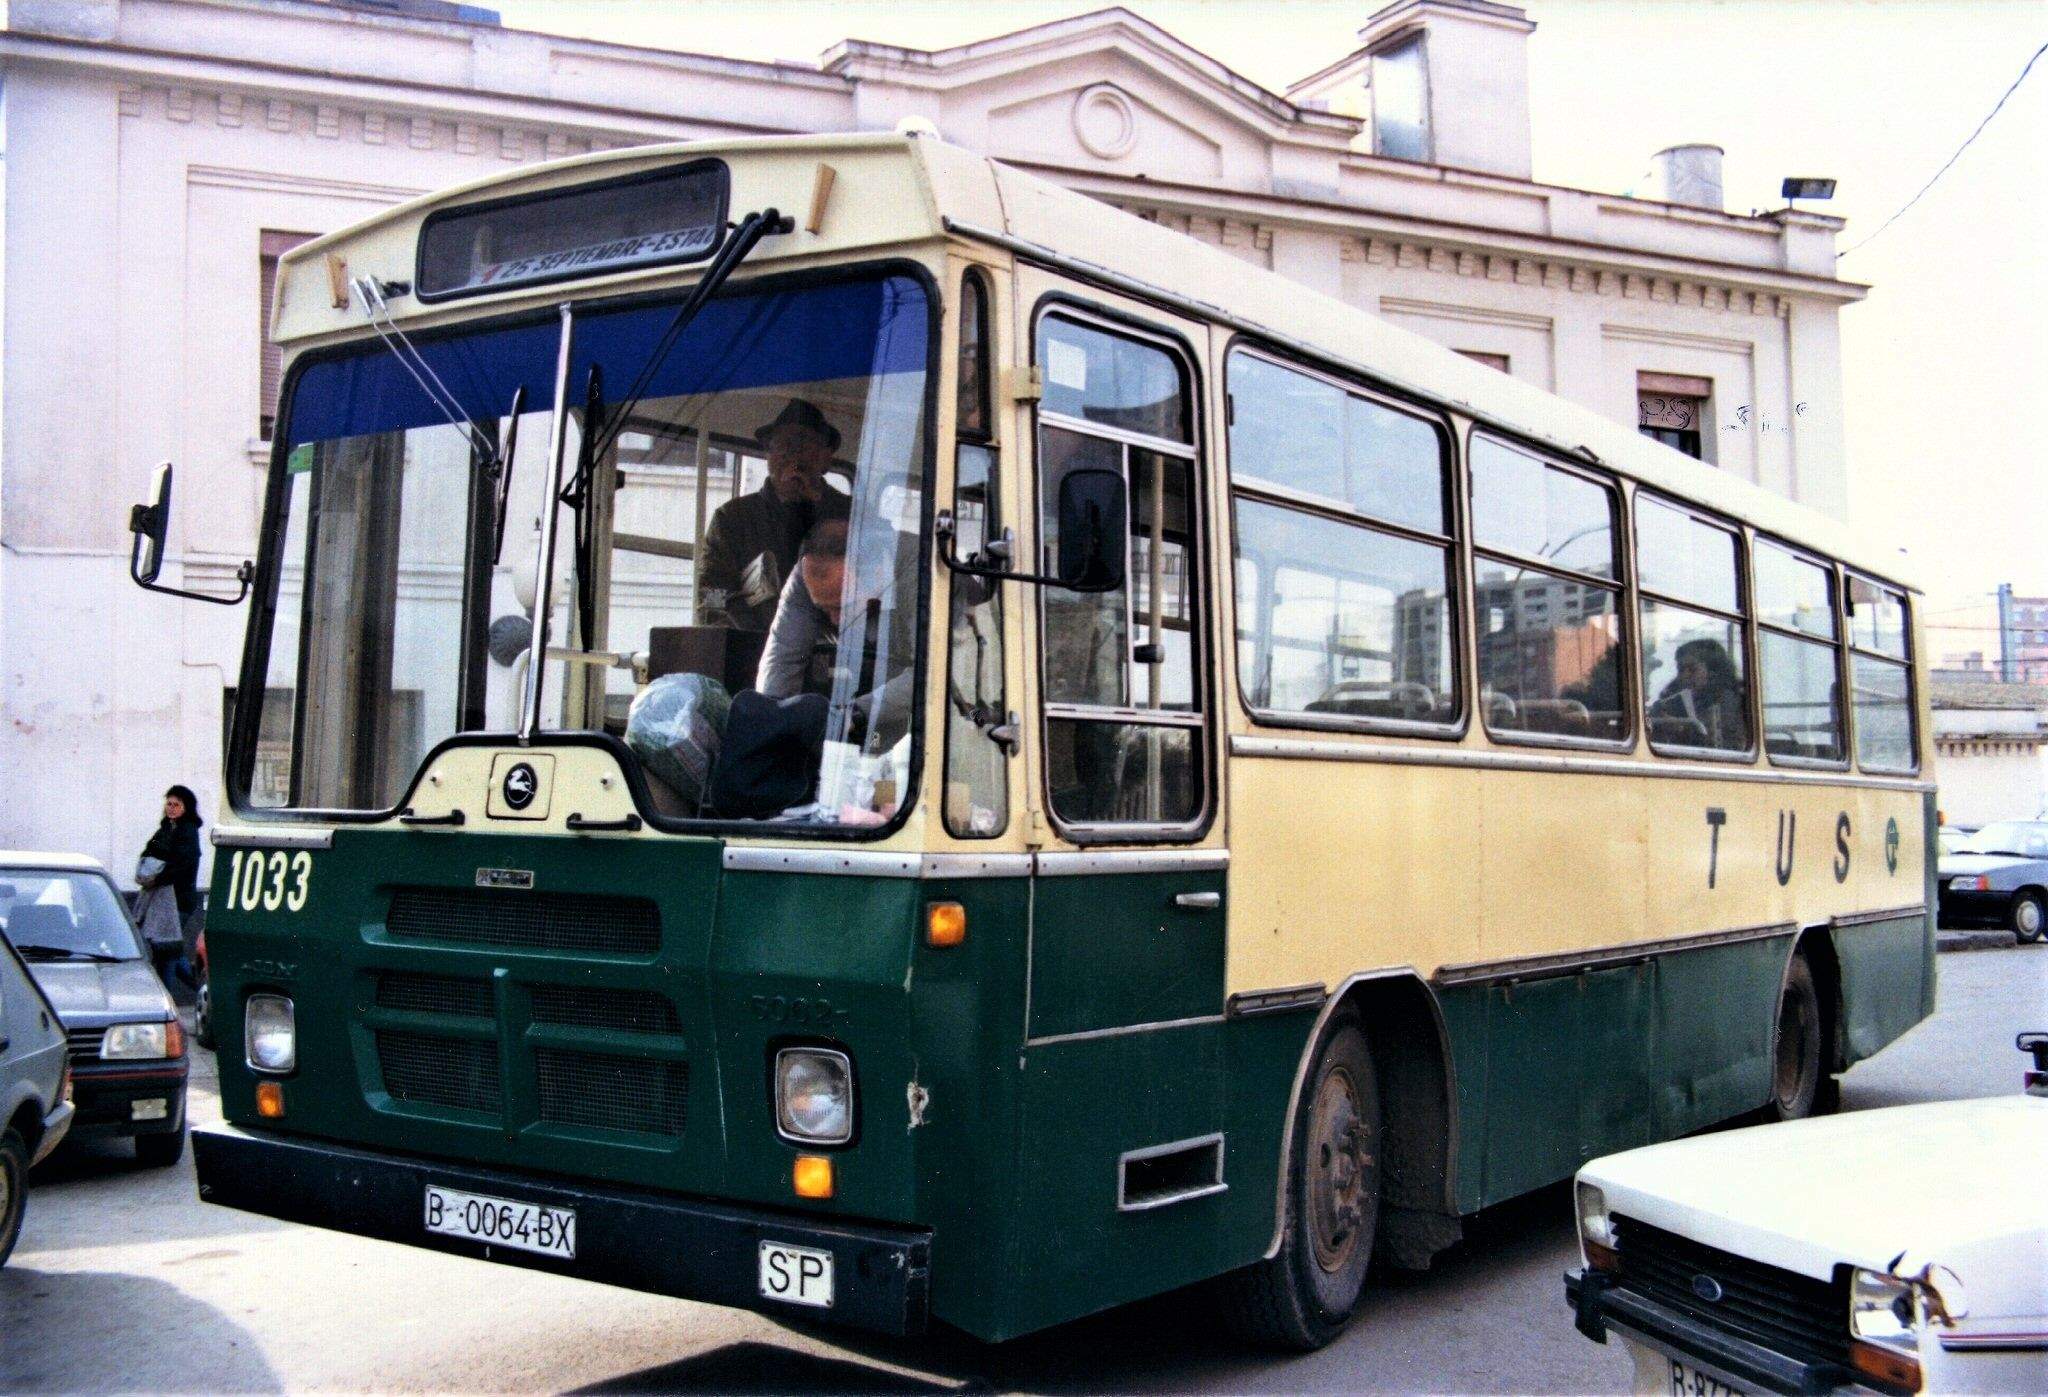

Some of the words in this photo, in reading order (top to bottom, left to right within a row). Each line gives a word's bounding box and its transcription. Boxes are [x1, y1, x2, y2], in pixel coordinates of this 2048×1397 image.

[501, 260, 535, 279] 25
[226, 850, 312, 911] 1033
[768, 1250, 823, 1296] SP
